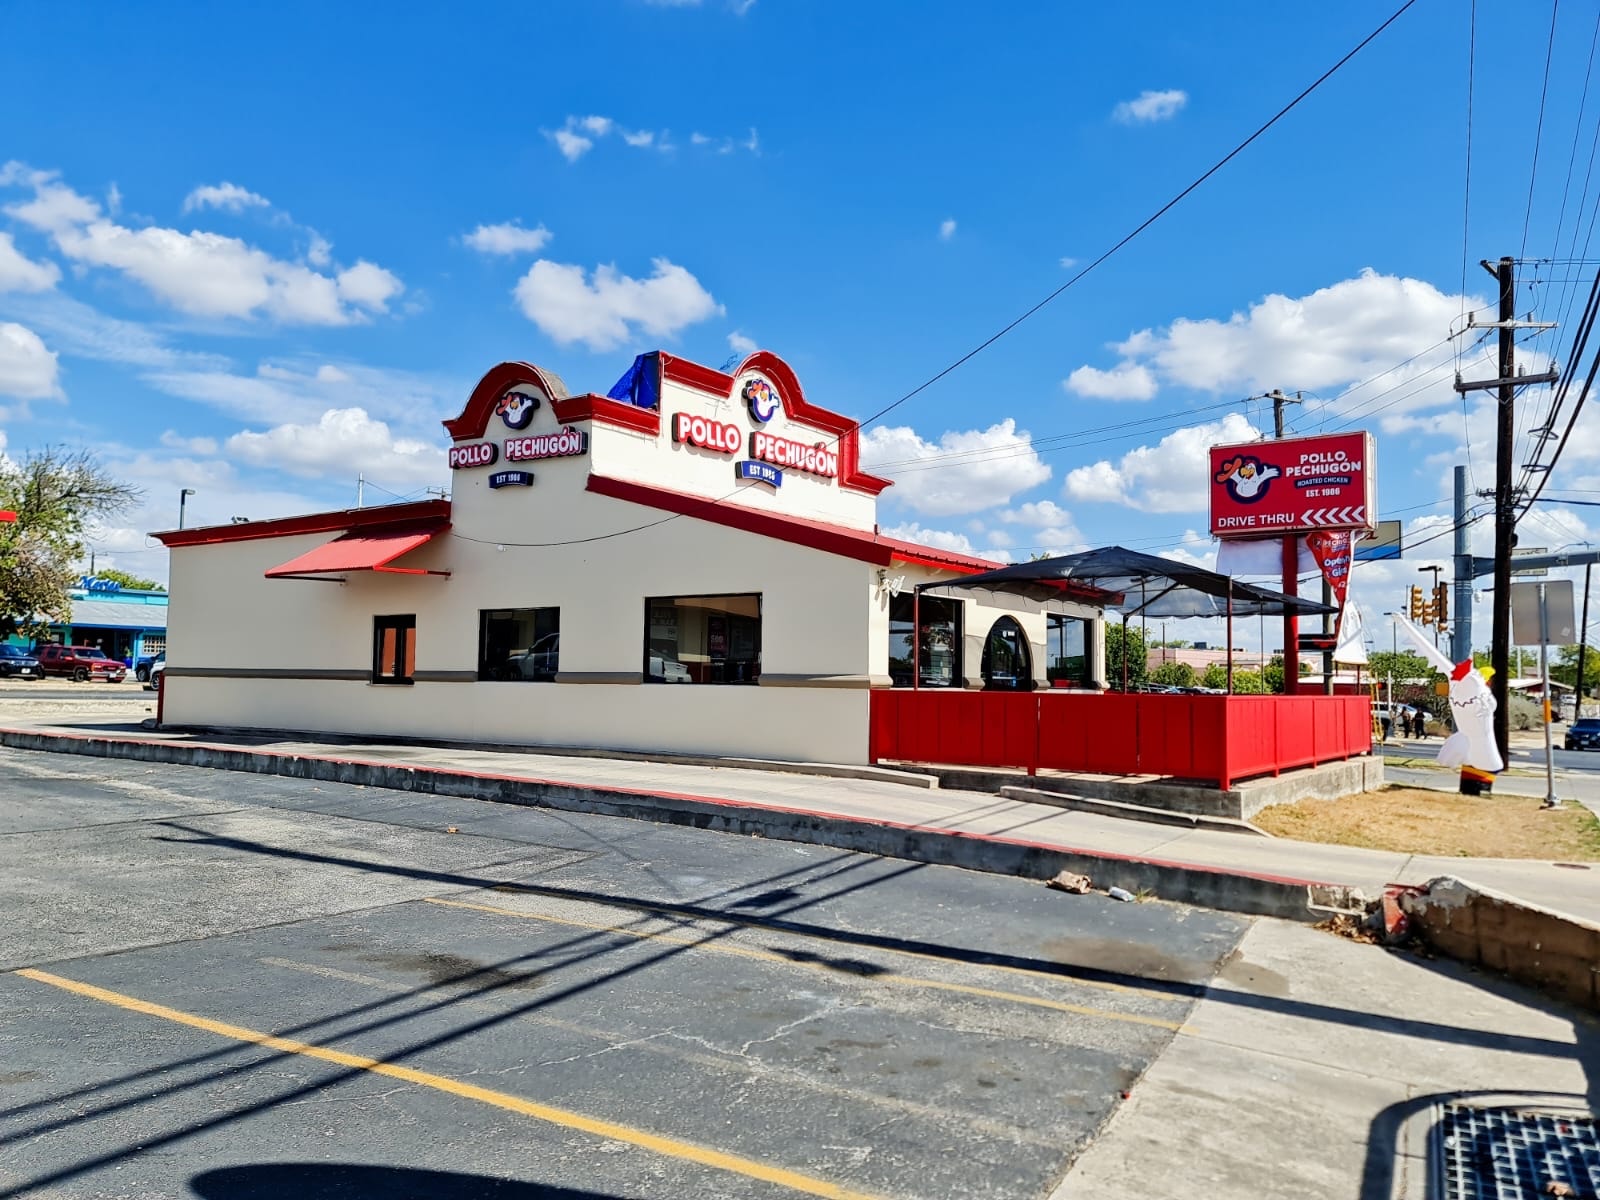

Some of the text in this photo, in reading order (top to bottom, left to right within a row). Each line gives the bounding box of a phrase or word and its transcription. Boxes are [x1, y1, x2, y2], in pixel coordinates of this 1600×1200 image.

[450, 427, 580, 466] POLLO PECHUGÓN
[678, 415, 838, 477] POLLO PECHUGÓN
[1300, 450, 1346, 464] POLLO
[749, 464, 761, 475] EST
[1285, 458, 1361, 477] PECHUGÓN
[496, 475, 506, 484] EST
[1305, 489, 1320, 498] EST.
[1218, 512, 1295, 528] DRIVE THRU
